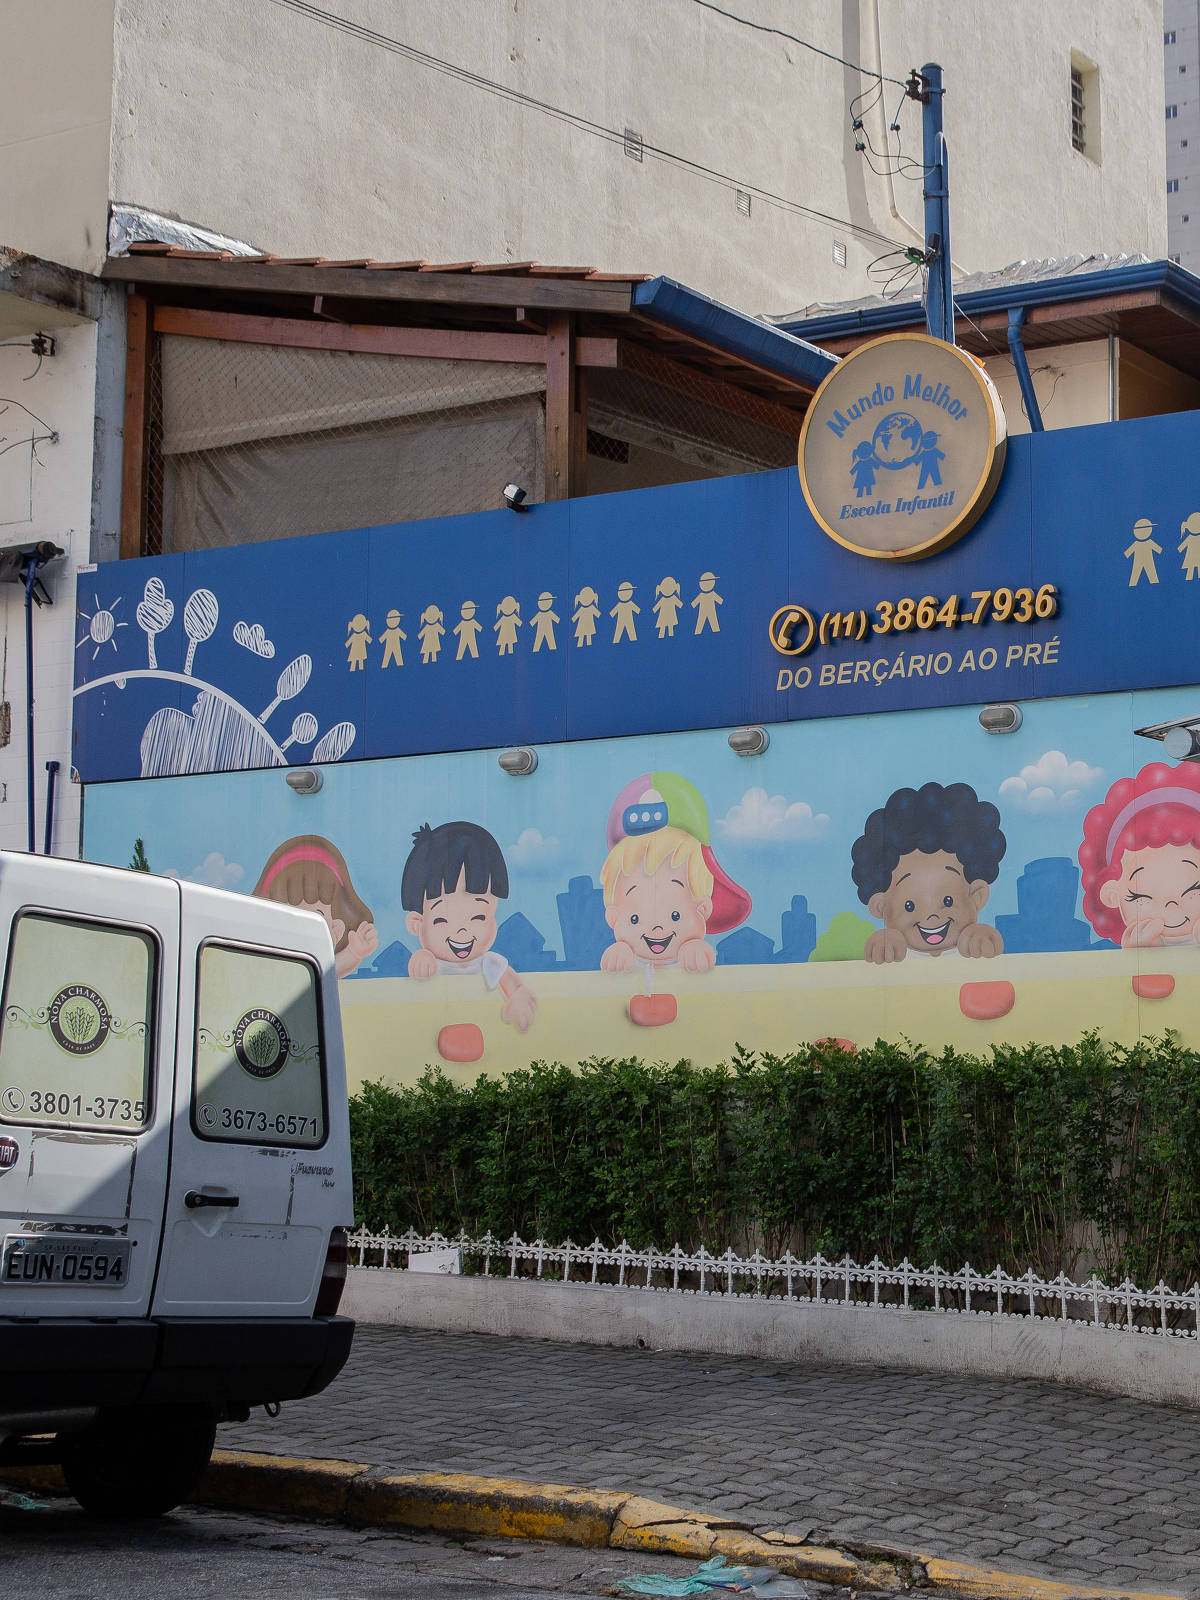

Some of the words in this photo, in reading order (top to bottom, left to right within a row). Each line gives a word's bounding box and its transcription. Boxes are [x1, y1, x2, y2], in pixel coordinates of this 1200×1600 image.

[826, 383, 894, 438] Mundo
[904, 374, 967, 421] Melhor
[839, 500, 891, 519] Escola
[895, 490, 954, 514] Infantil
[819, 610, 868, 645] (11)
[872, 584, 1058, 635] 3864-7936
[777, 666, 811, 690] DO
[819, 652, 952, 686] BERÇÁRIO
[958, 647, 997, 672] AO
[1005, 636, 1061, 668] PRÉ
[51, 993, 67, 1023] NOVA
[68, 987, 108, 1030] CHARMOSA
[236, 1017, 250, 1047] NOVA
[251, 1011, 288, 1053] CHARMOSA
[30, 1090, 145, 1122] 3801-3735
[221, 1107, 318, 1137] 3673-6571
[0, 1145, 15, 1163] IAT
